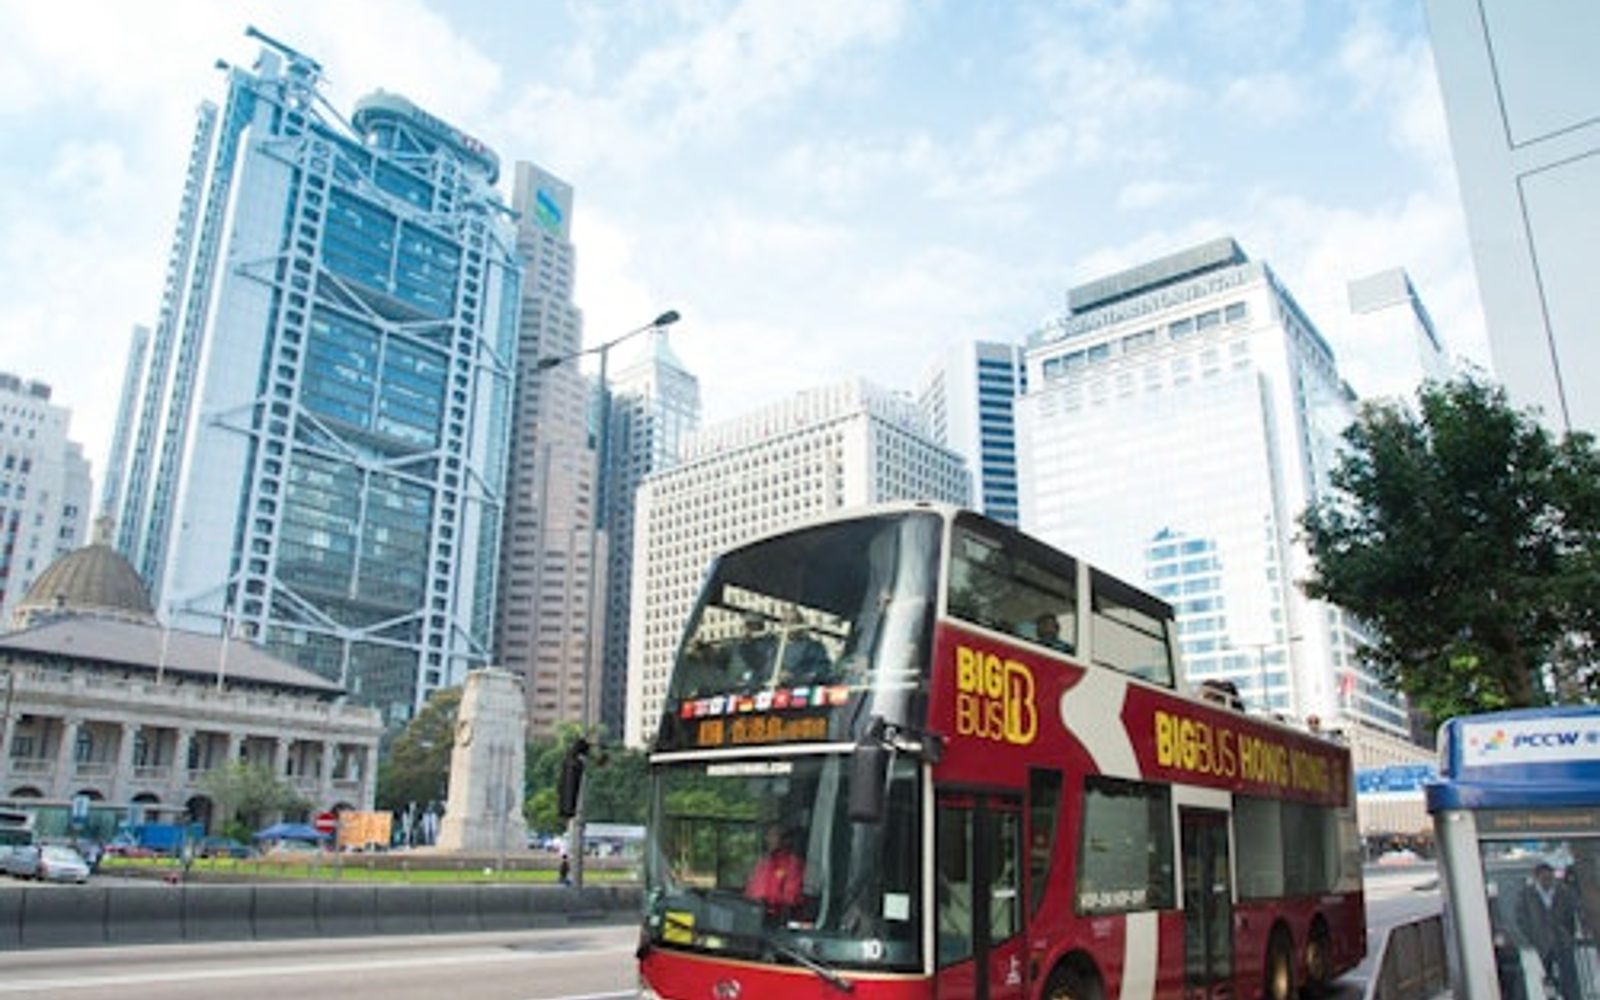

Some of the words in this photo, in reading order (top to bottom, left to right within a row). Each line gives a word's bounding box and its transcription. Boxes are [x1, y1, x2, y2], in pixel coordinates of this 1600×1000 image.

[956, 646, 1003, 699] BIG
[957, 693, 1003, 741] BUS
[1512, 731, 1580, 749] PCCW
